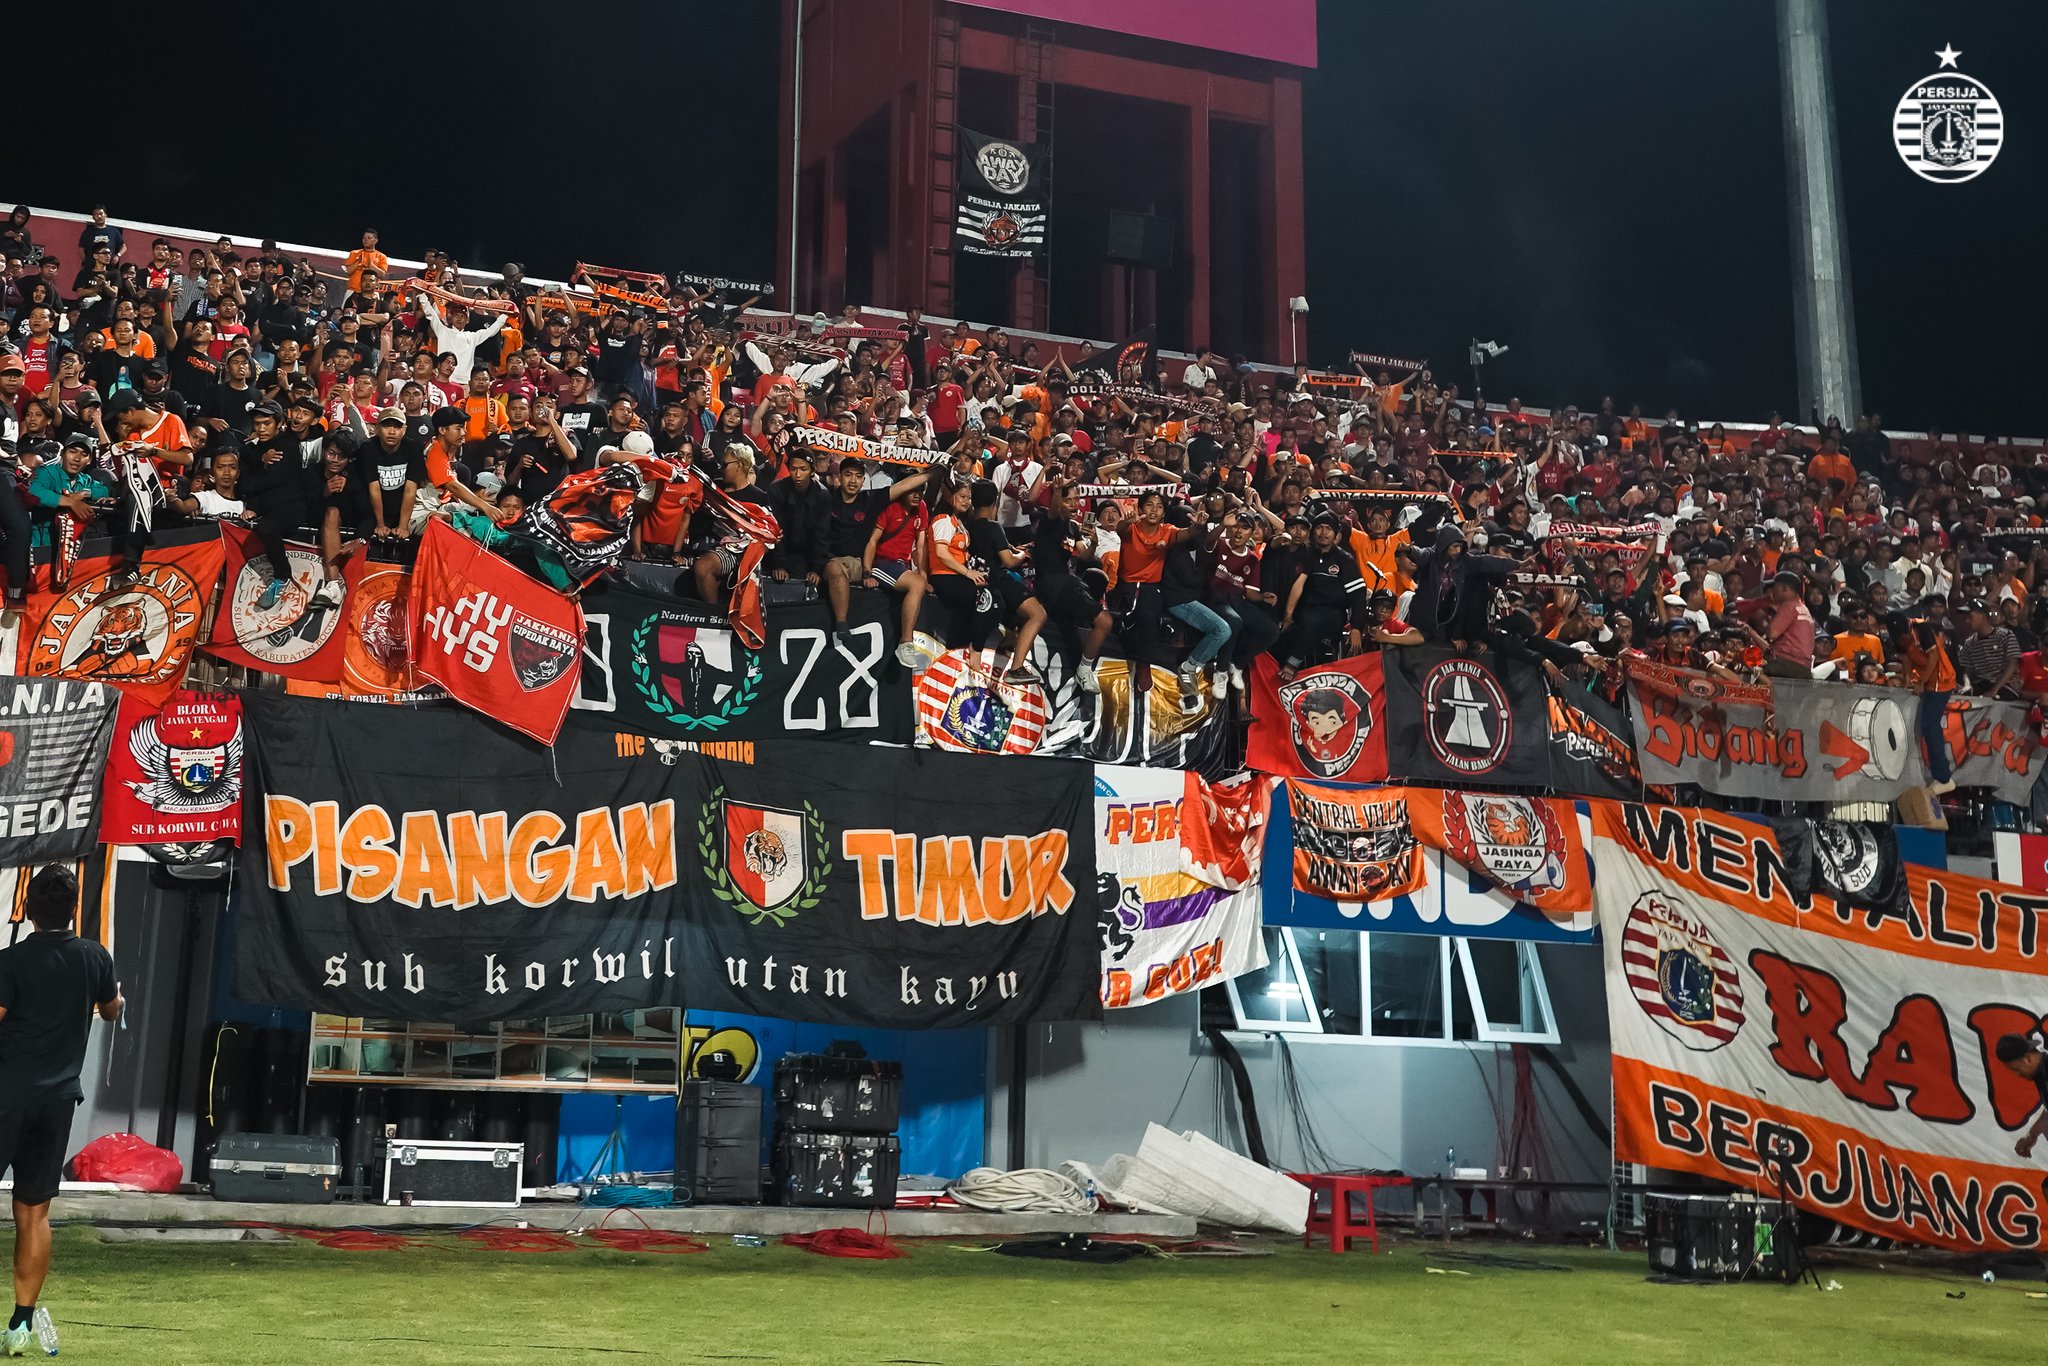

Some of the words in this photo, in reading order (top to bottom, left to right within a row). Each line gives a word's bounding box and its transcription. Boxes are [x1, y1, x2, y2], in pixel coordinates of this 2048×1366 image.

[980, 153, 1026, 173] AWAY
[983, 165, 1024, 184] DAY
[967, 195, 1002, 210] PERSIJA
[1003, 203, 1041, 213] JAKARTA
[1311, 375, 1356, 385] PERSIJA
[793, 426, 858, 452] PERSIJA
[660, 610, 705, 624] Northern
[516, 615, 578, 647] JAKMANIA
[513, 624, 550, 646] CIPEDAK
[548, 639, 576, 657] RAYA
[1440, 662, 1455, 677] JAK
[1456, 661, 1482, 678] MANIA
[1305, 674, 1357, 699] SUNDA
[176, 703, 217, 716] BLORA
[166, 717, 192, 725] JAWA
[191, 714, 228, 724] TENGAH
[1445, 753, 1470, 771] JALAN
[163, 805, 189, 813] MACAN
[131, 822, 155, 835] SUB
[157, 820, 208, 835] KORWIL
[264, 792, 678, 911] PISANGAN
[842, 828, 1076, 928] TIMUR
[1481, 847, 1543, 858] JASINGA
[1493, 859, 1532, 870] RAYA
[1307, 860, 1359, 895] AWAY
[1849, 863, 1872, 888] SUD
[322, 951, 426, 995] sub
[483, 936, 677, 995] korwil
[724, 954, 849, 998] utan
[900, 965, 1020, 1012] kayu
[1648, 1079, 2042, 1249] BERJUANG
